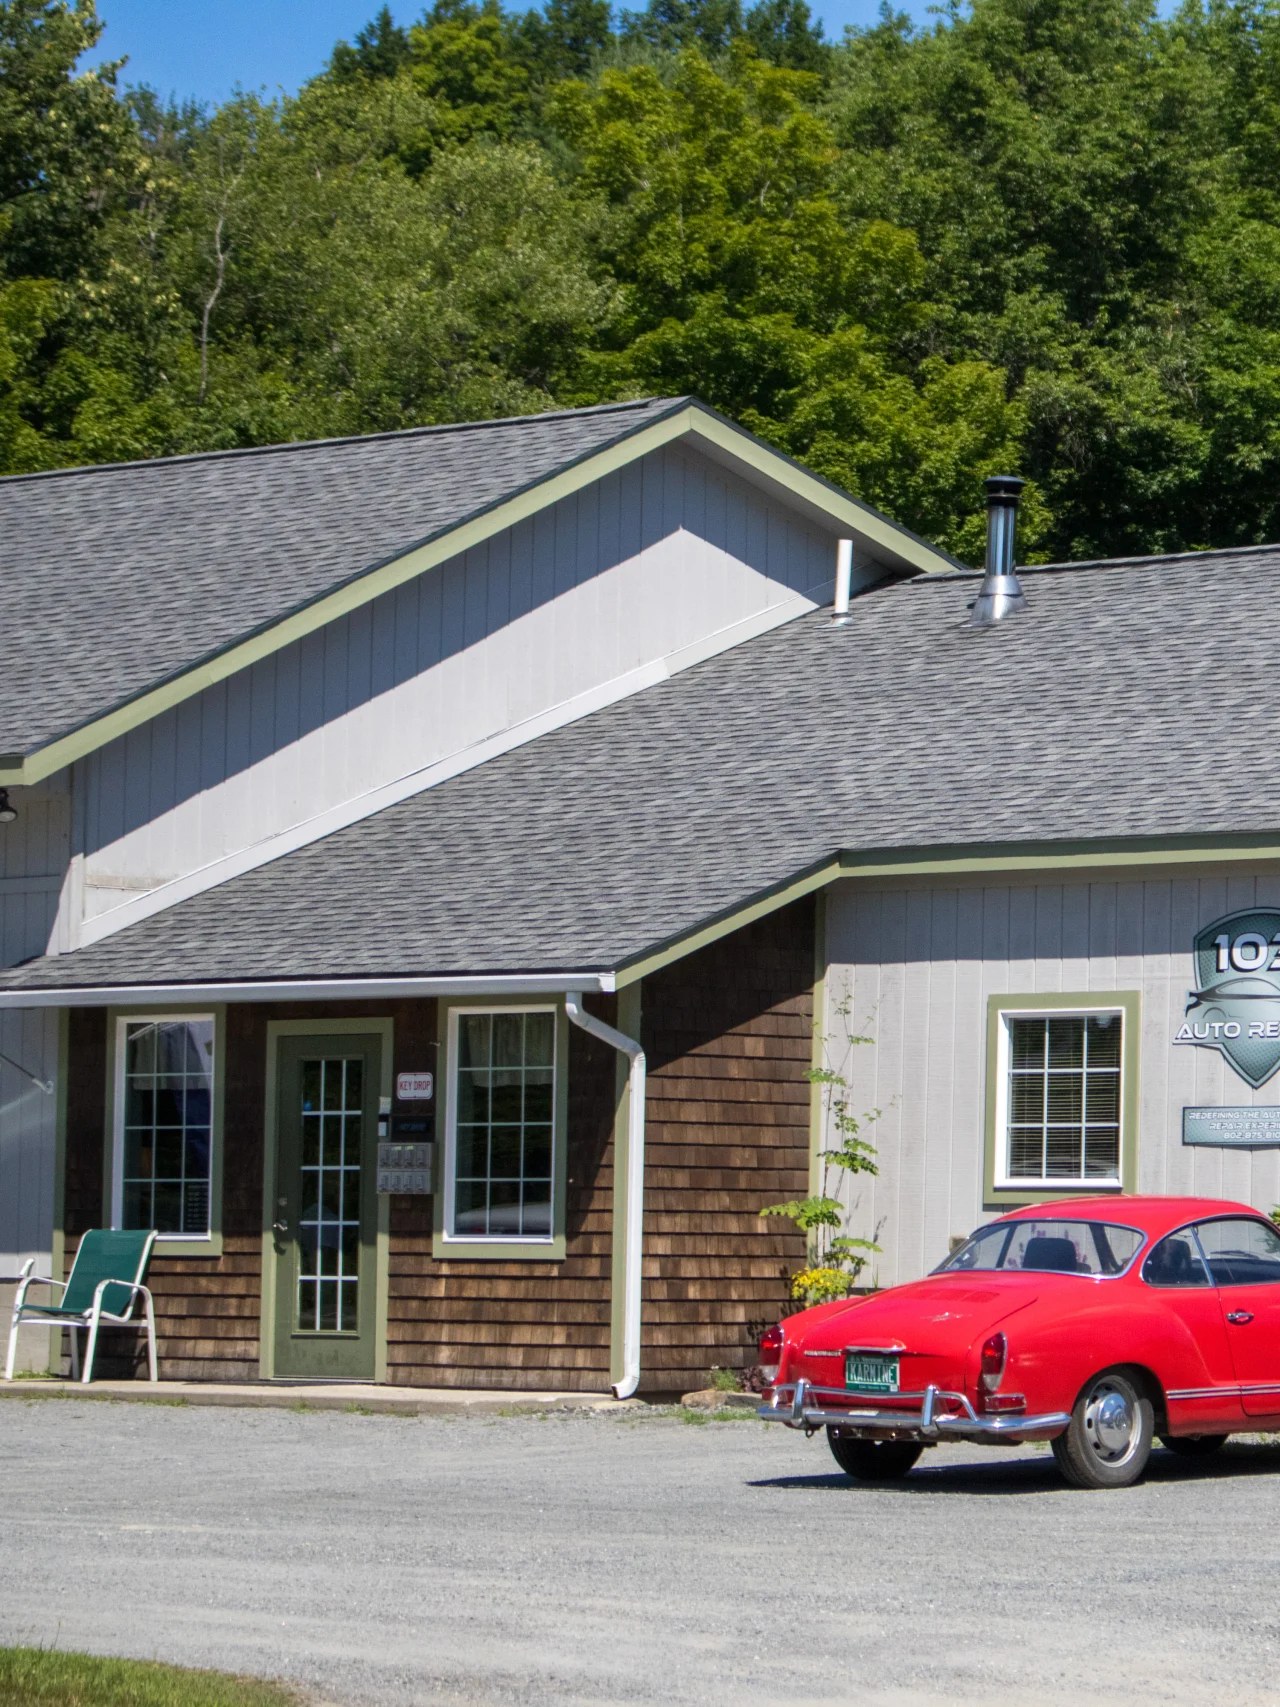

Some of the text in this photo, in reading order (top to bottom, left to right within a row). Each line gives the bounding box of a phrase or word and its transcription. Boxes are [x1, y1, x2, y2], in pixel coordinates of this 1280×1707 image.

[1175, 1021, 1241, 1040] AUTO
[400, 1080, 431, 1091] KEY DROP
[1242, 1111, 1260, 1119] THE
[1209, 1122, 1244, 1130] REPAIR
[850, 1363, 895, 1383] KARMINE
